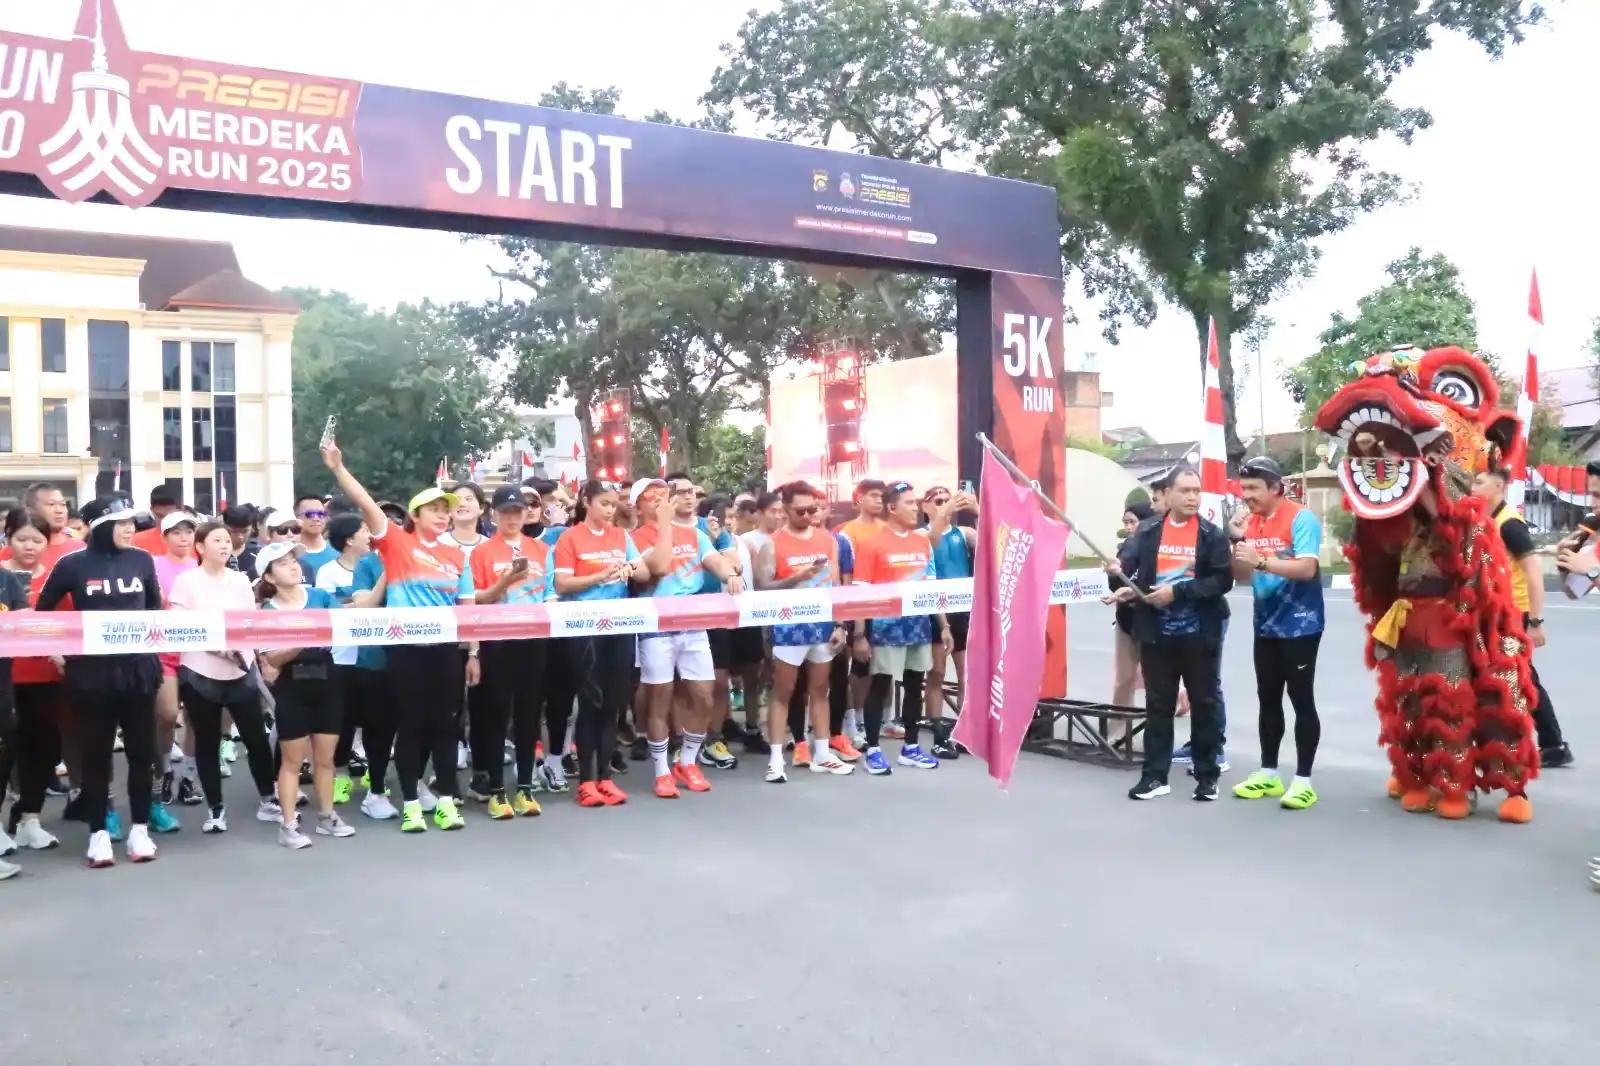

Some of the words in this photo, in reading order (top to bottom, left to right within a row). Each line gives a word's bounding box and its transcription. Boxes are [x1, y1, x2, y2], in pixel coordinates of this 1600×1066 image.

[136, 63, 350, 118] PRESISI
[150, 104, 351, 156] MERDEKA
[167, 146, 248, 182] RUN
[257, 157, 351, 191] 2025
[445, 114, 632, 209] START
[1003, 312, 1054, 379] 5K
[1023, 385, 1054, 413] RUN
[1012, 531, 1034, 575] 2025
[86, 576, 143, 596] FILA
[129, 633, 142, 643] TO
[164, 627, 207, 635] MERDEKA
[349, 627, 373, 638] ROAD
[374, 626, 384, 637] TO
[423, 627, 441, 636] 2025
